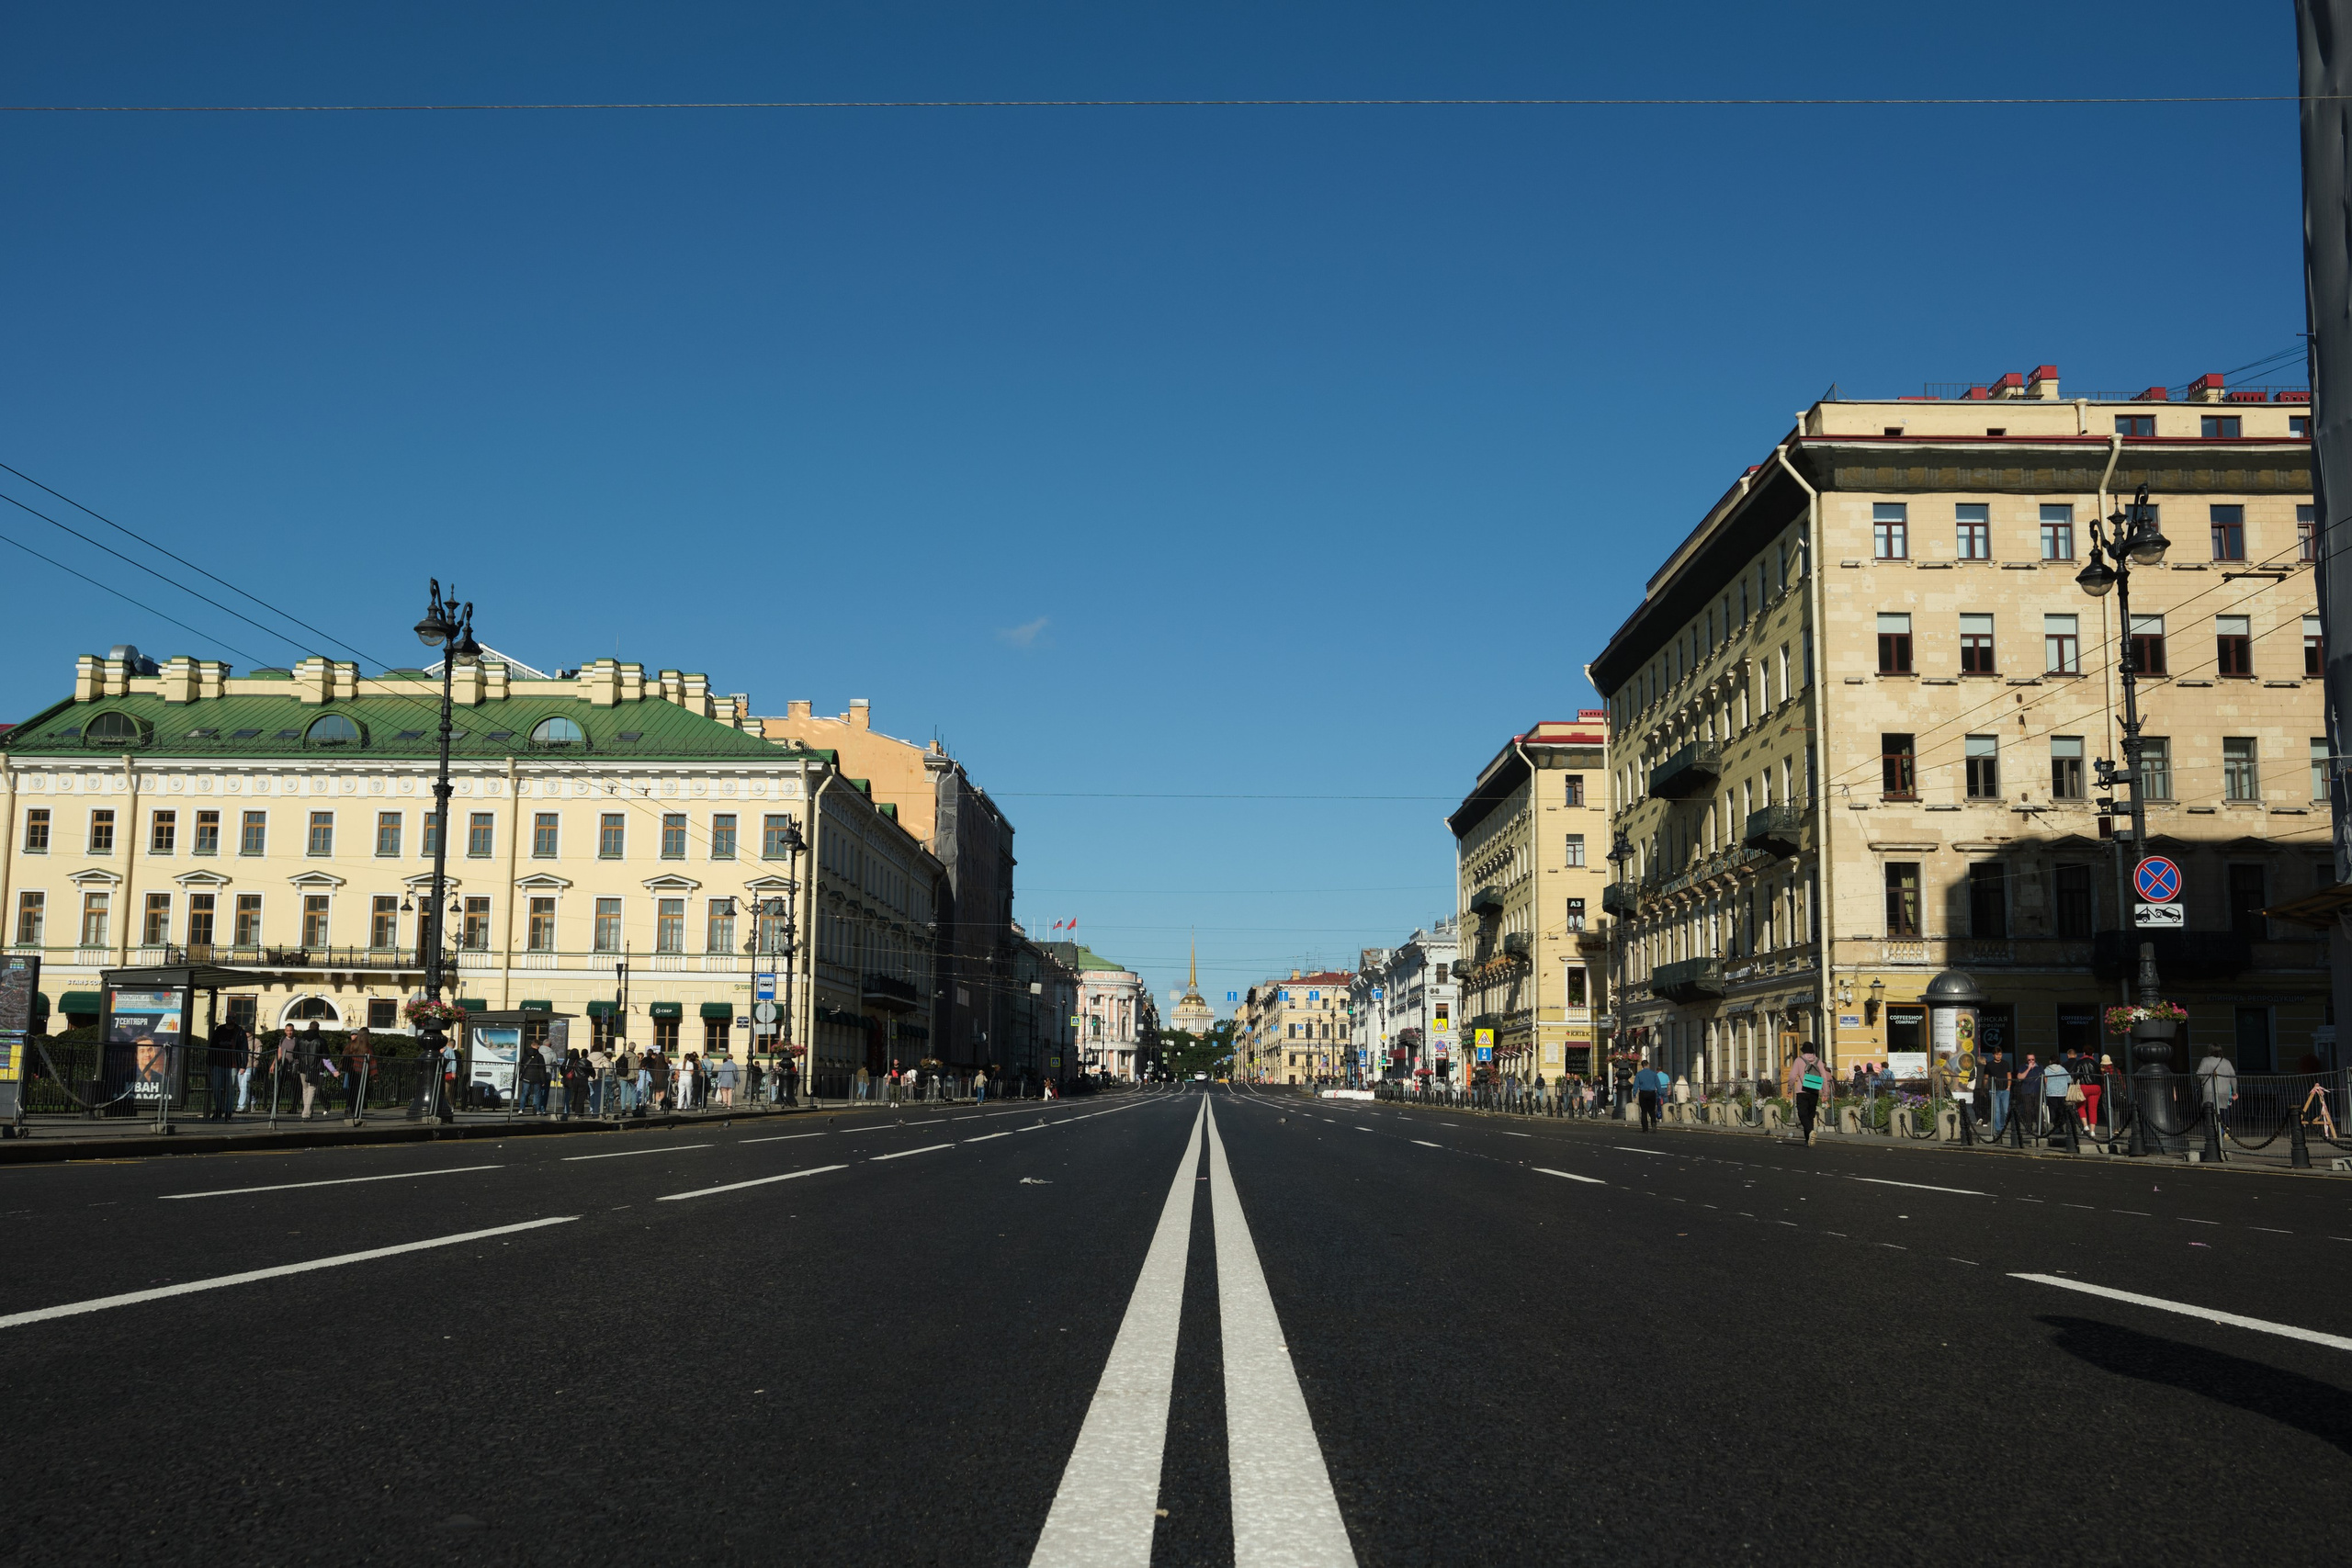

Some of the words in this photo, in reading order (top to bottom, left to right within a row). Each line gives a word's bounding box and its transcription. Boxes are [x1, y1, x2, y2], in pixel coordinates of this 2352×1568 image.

[2207, 995, 2244, 1003] КЛИНИКА
[2247, 995, 2305, 1004] РЕПРОДУКЦИИ
[119, 1017, 149, 1026] СЕНТЯБРЯ
[1986, 1032, 1999, 1042] 24
